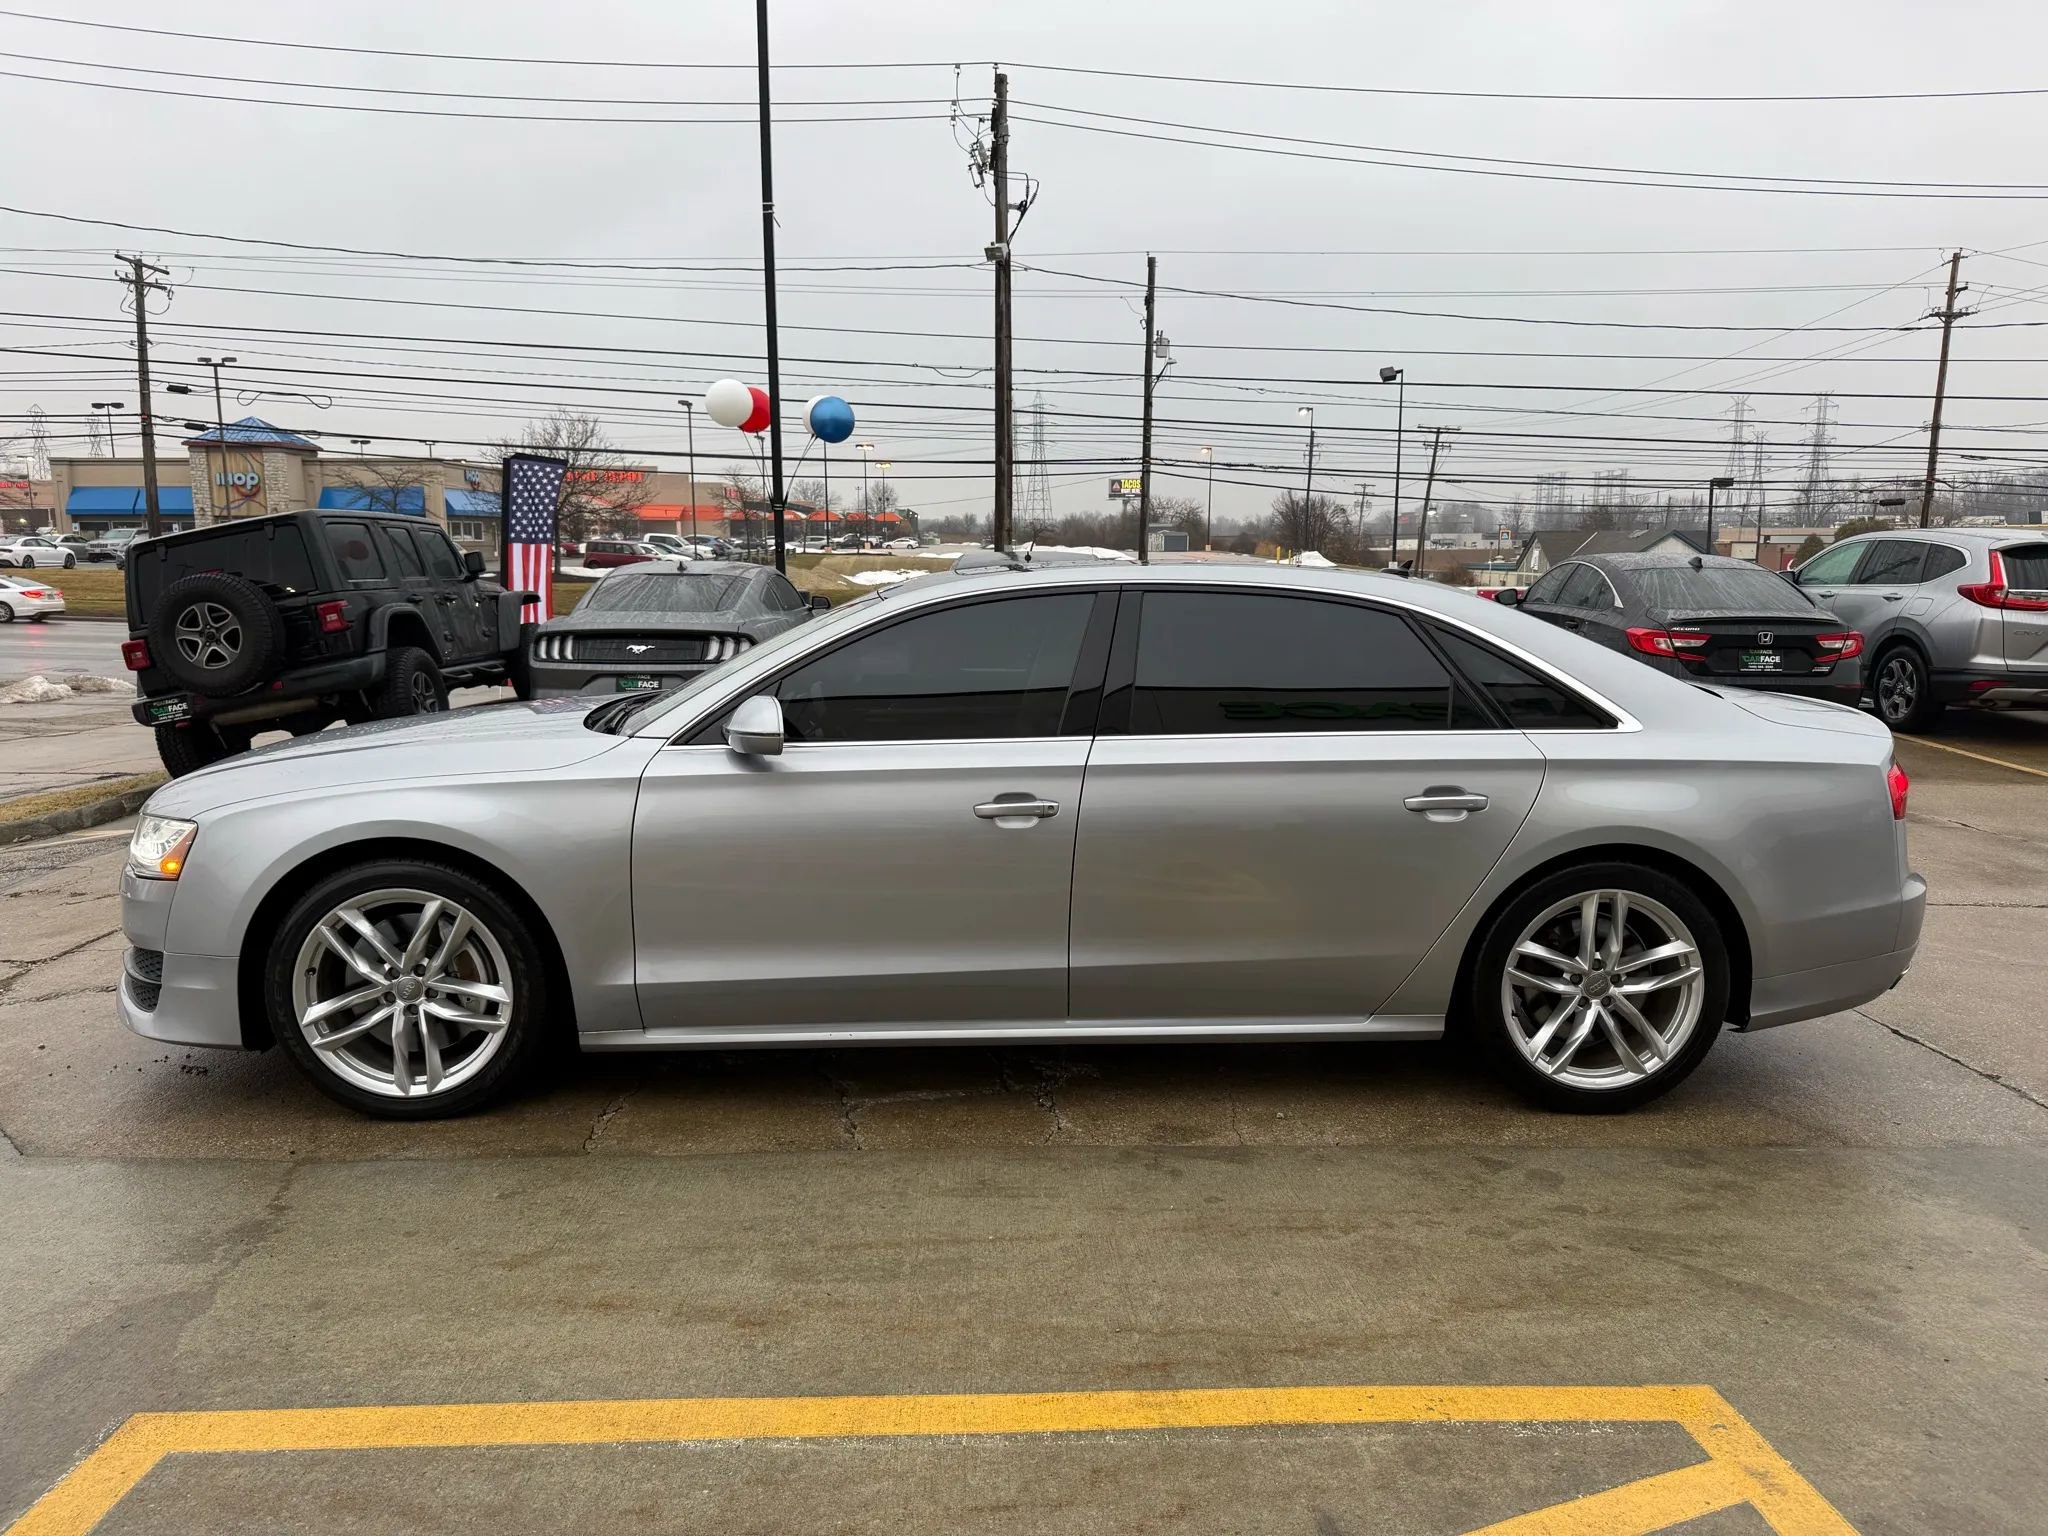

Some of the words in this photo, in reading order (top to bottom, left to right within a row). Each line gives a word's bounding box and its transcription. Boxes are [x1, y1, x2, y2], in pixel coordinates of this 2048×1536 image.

[1120, 479, 1141, 489] TACOS
[1742, 655, 1781, 663] CARFACE
[620, 680, 660, 688] CARFACE
[150, 702, 189, 715] CARFACE
